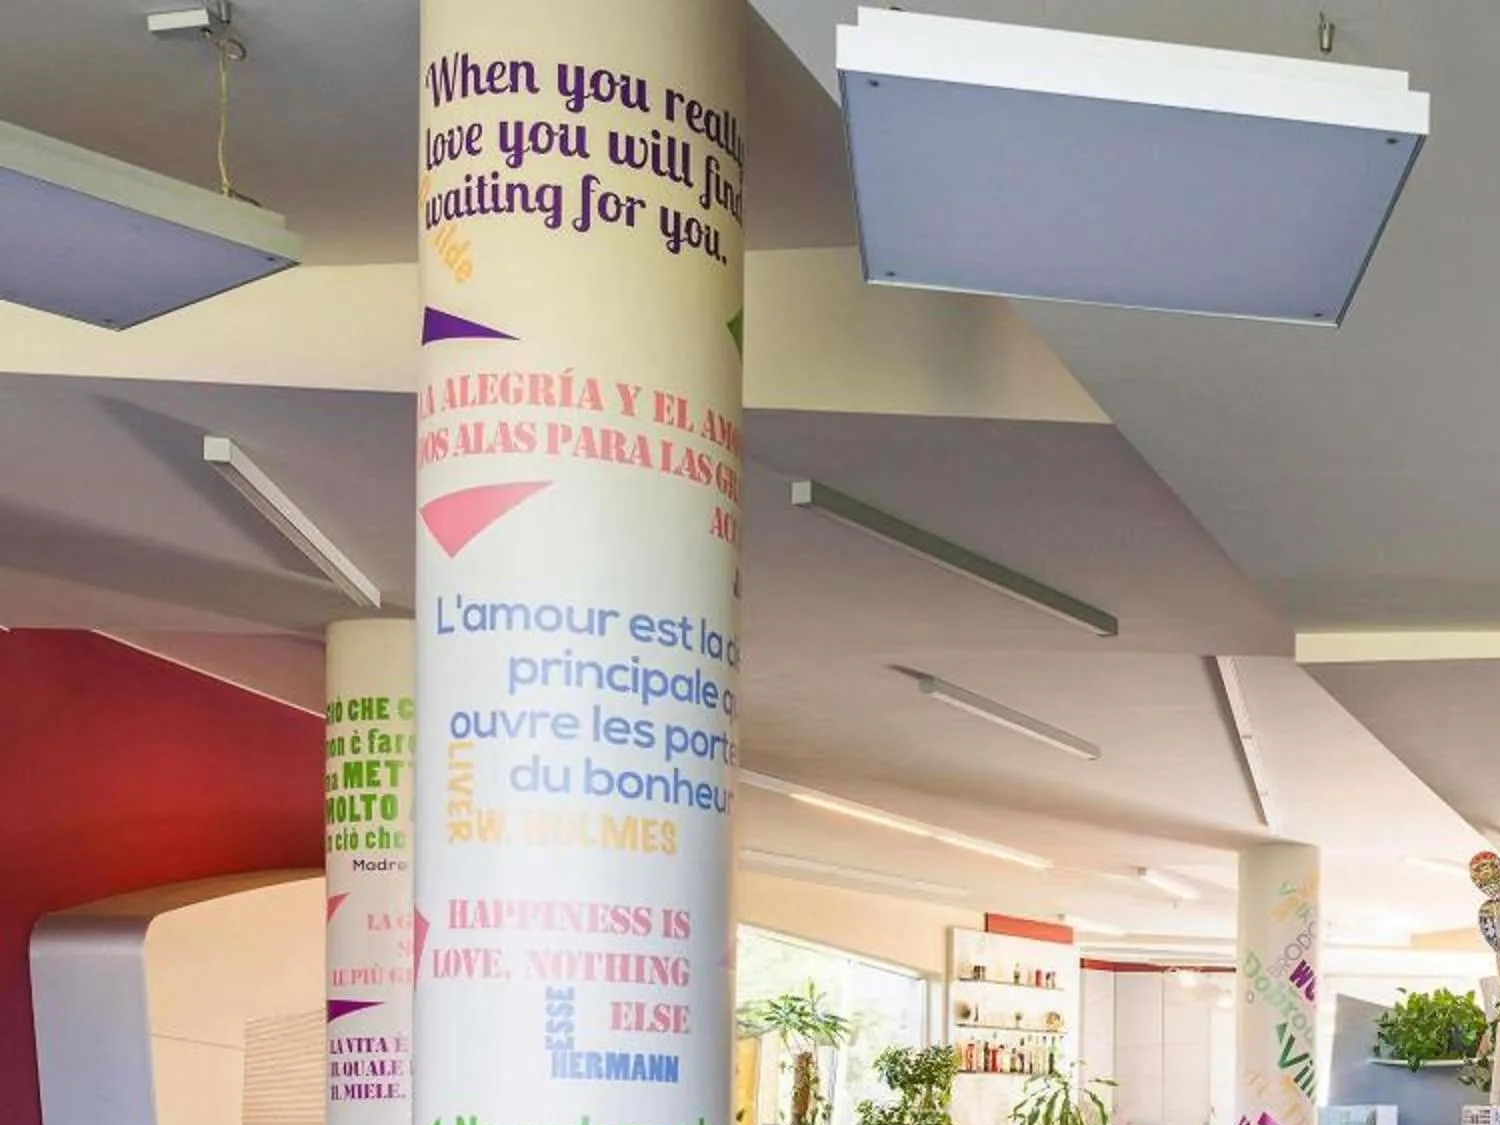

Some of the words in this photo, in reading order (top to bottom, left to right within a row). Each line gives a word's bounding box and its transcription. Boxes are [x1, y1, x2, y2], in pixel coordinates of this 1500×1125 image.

[425, 52, 540, 107] When
[557, 63, 650, 113] you
[425, 122, 483, 171] love
[499, 121, 590, 168] you
[608, 130, 693, 188] will
[425, 171, 562, 230] waiting
[572, 174, 646, 232] for
[660, 206, 727, 264] you.
[441, 368, 603, 411] ALEGRÍA
[615, 382, 641, 417] Y
[653, 390, 694, 432] EL
[453, 421, 537, 457] ALAS
[546, 422, 653, 468] PARA
[659, 439, 713, 486] LAS
[437, 594, 619, 636] L'amour
[629, 612, 694, 651] est
[701, 617, 723, 661] la
[508, 648, 719, 709] principale
[347, 697, 390, 721] CHE
[450, 709, 580, 740] ouvre
[592, 704, 656, 749] les
[343, 760, 416, 789] MET
[509, 754, 571, 794] du
[326, 793, 399, 825] MOLTO
[365, 826, 407, 850] che
[522, 810, 678, 856] HOLMES
[353, 859, 408, 872] Madre
[448, 898, 652, 937] HAPPINESS
[661, 909, 691, 940] IS
[432, 948, 512, 983] LOVE,
[525, 951, 690, 988] NOTHING
[610, 1001, 690, 1034] ELSE
[345, 1036, 388, 1053] VITA
[342, 1059, 404, 1078] QUALE
[551, 1050, 679, 1084] HERMANN
